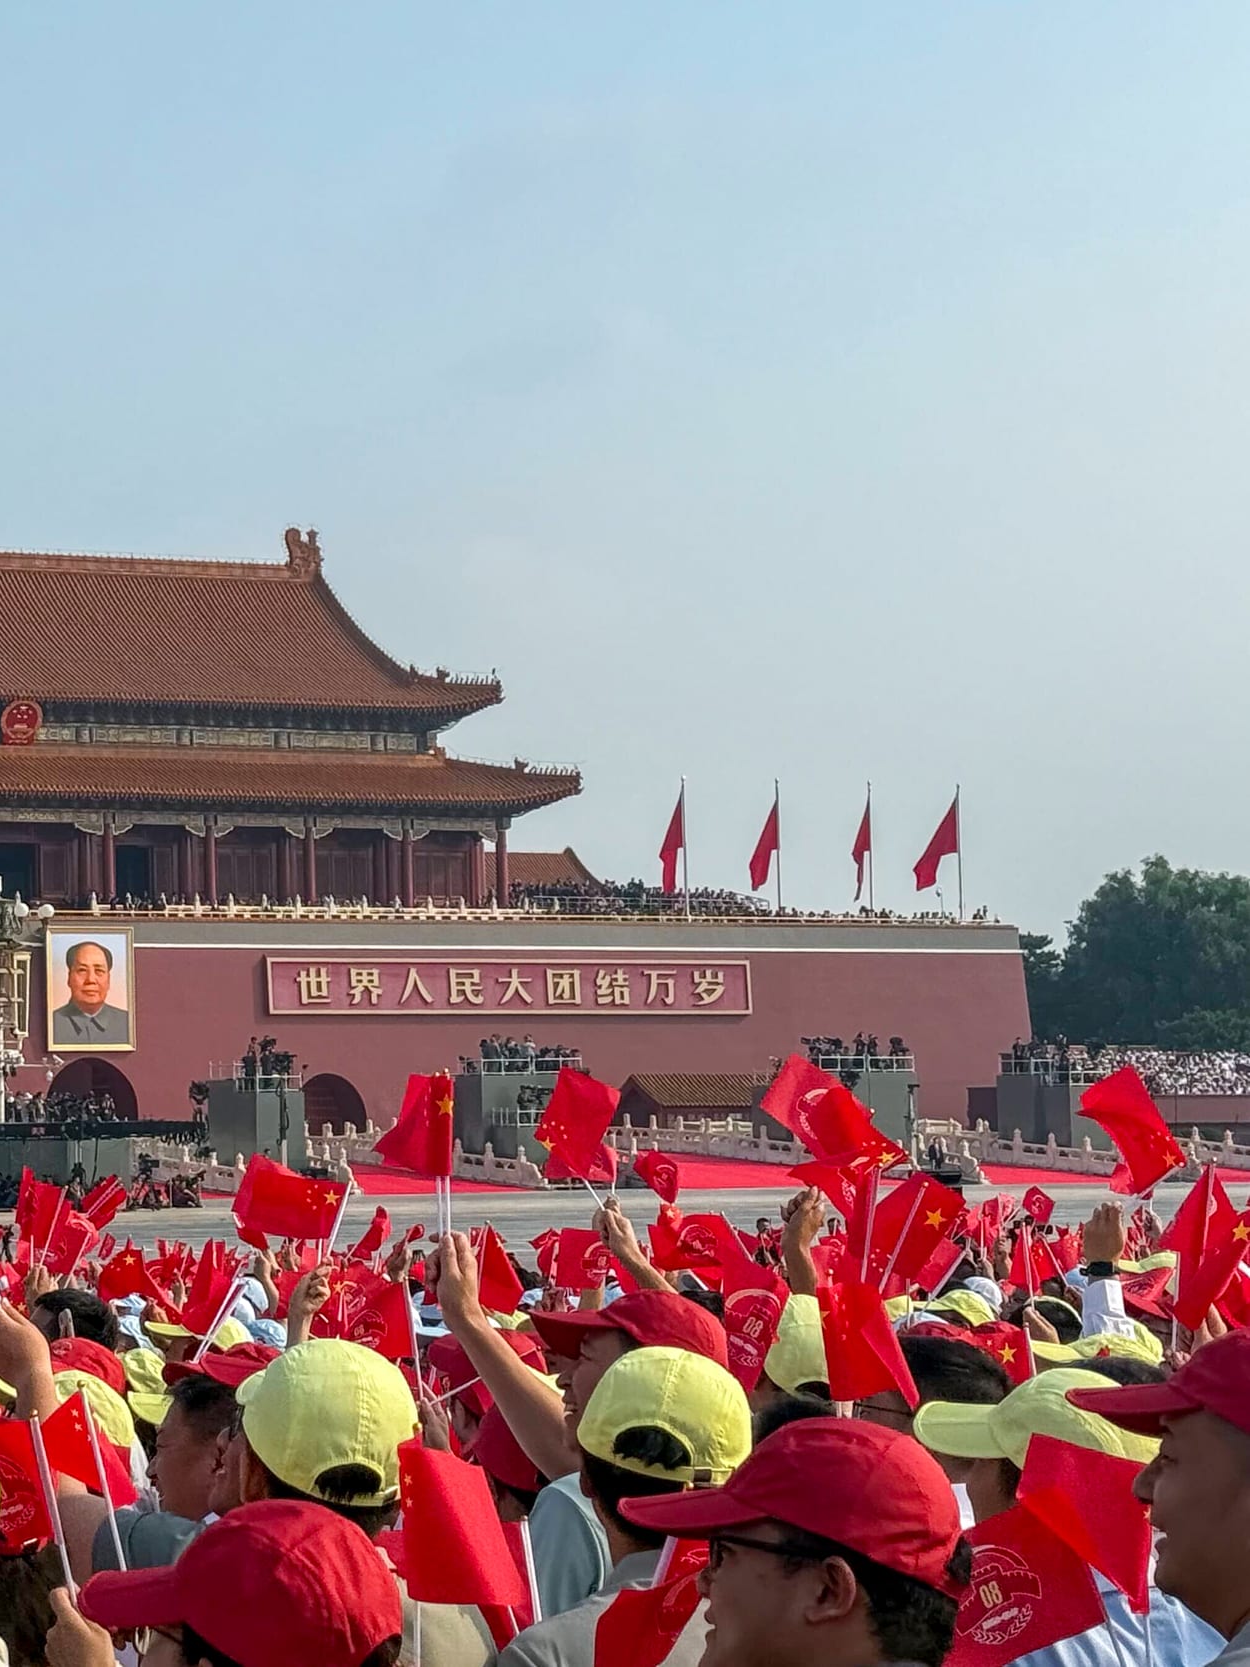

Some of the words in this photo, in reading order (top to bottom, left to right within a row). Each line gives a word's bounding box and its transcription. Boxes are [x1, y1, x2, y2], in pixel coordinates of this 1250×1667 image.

[295, 966, 726, 1006] 世界人民大团结万岁
